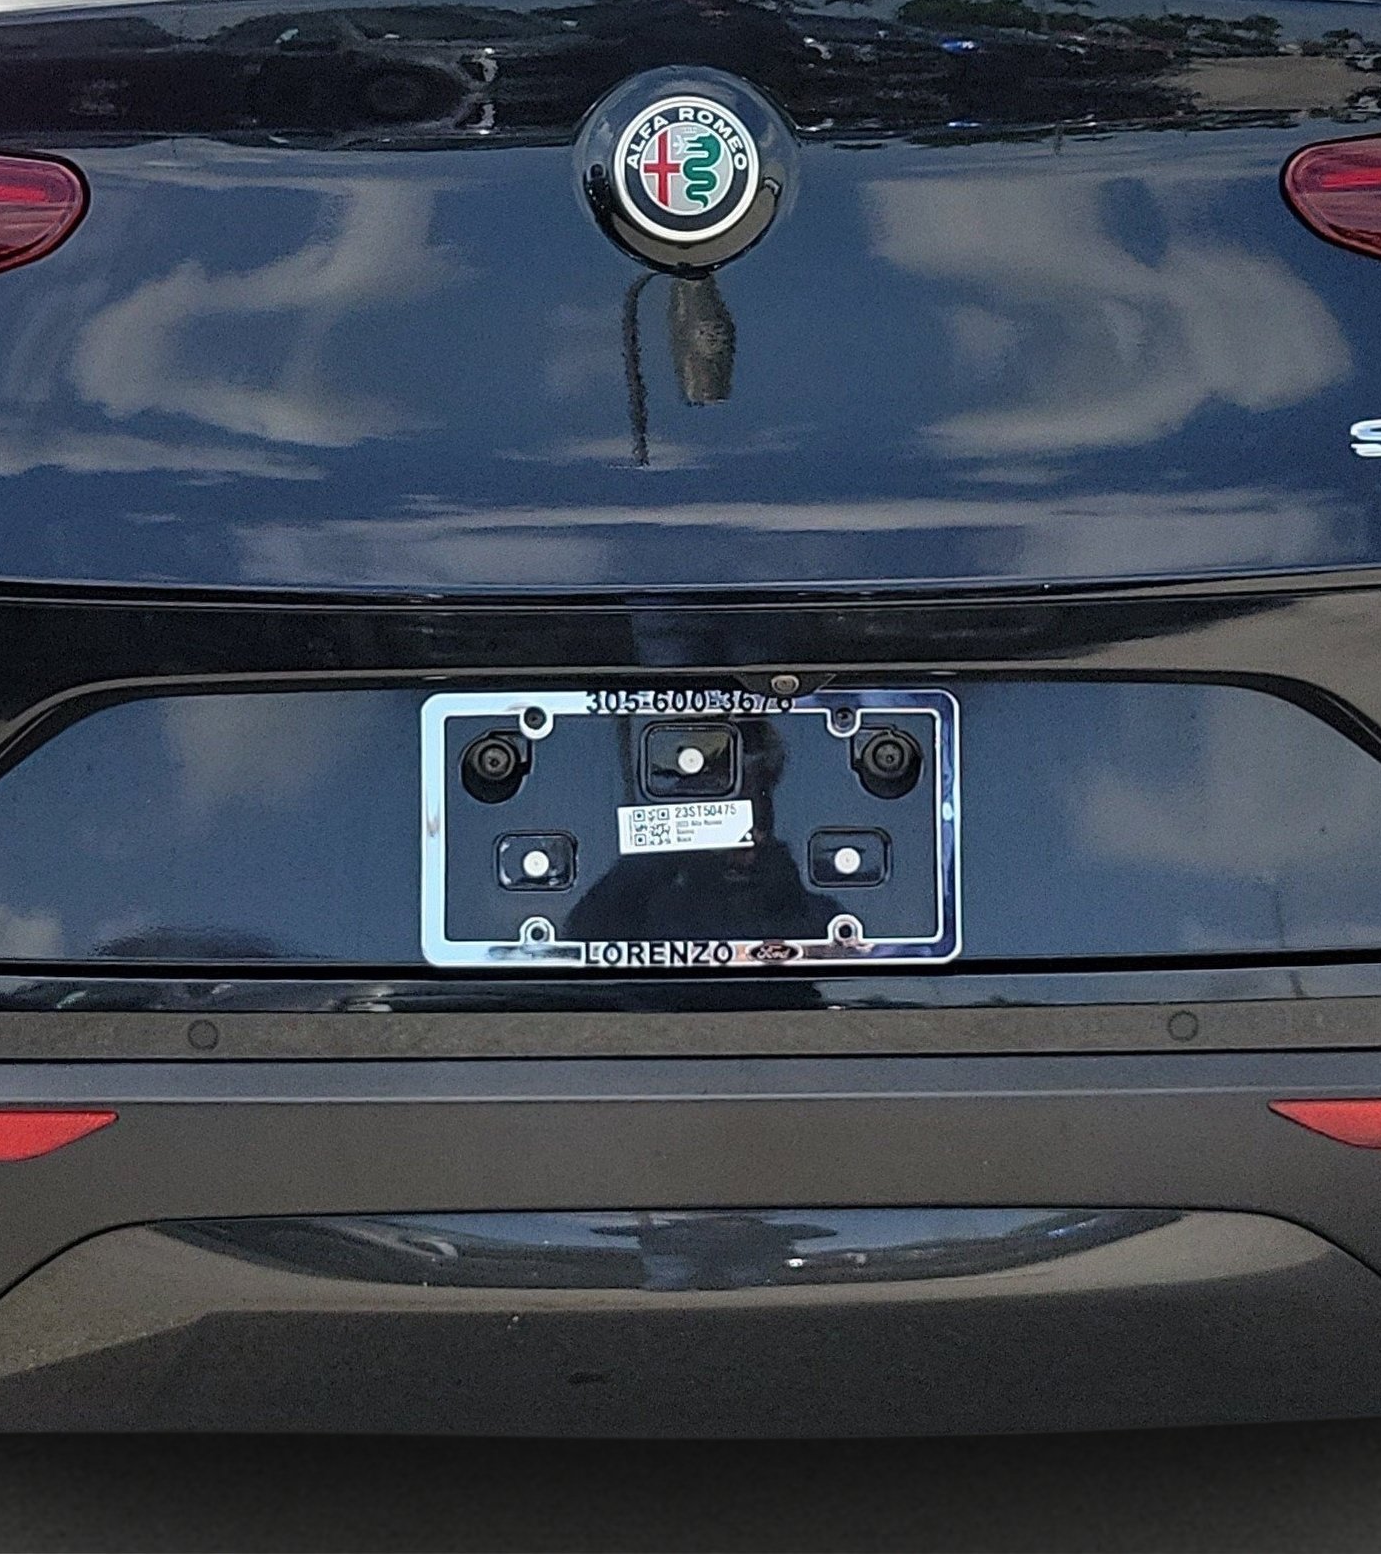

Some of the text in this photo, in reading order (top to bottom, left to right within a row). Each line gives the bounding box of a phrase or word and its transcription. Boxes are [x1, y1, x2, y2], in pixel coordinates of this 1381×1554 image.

[626, 106, 748, 171] ALFA ROMEO
[584, 941, 734, 965] LORENZO
